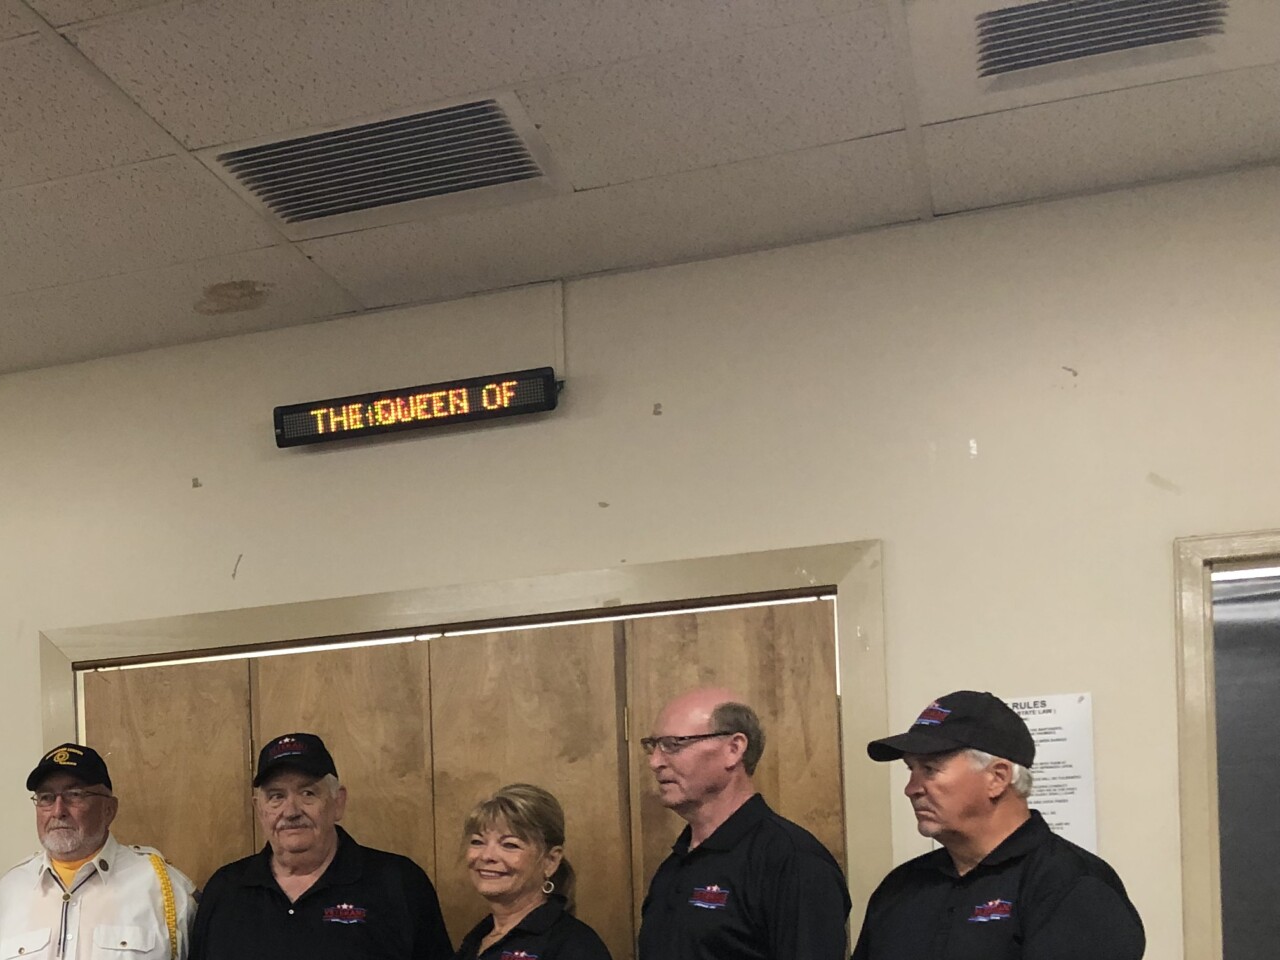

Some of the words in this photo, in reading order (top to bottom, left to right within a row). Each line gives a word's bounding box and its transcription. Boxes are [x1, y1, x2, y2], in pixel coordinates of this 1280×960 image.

[310, 403, 364, 434] THE
[373, 388, 469, 426] QUEEN
[481, 380, 518, 410] OF
[1012, 700, 1047, 710] RULES
